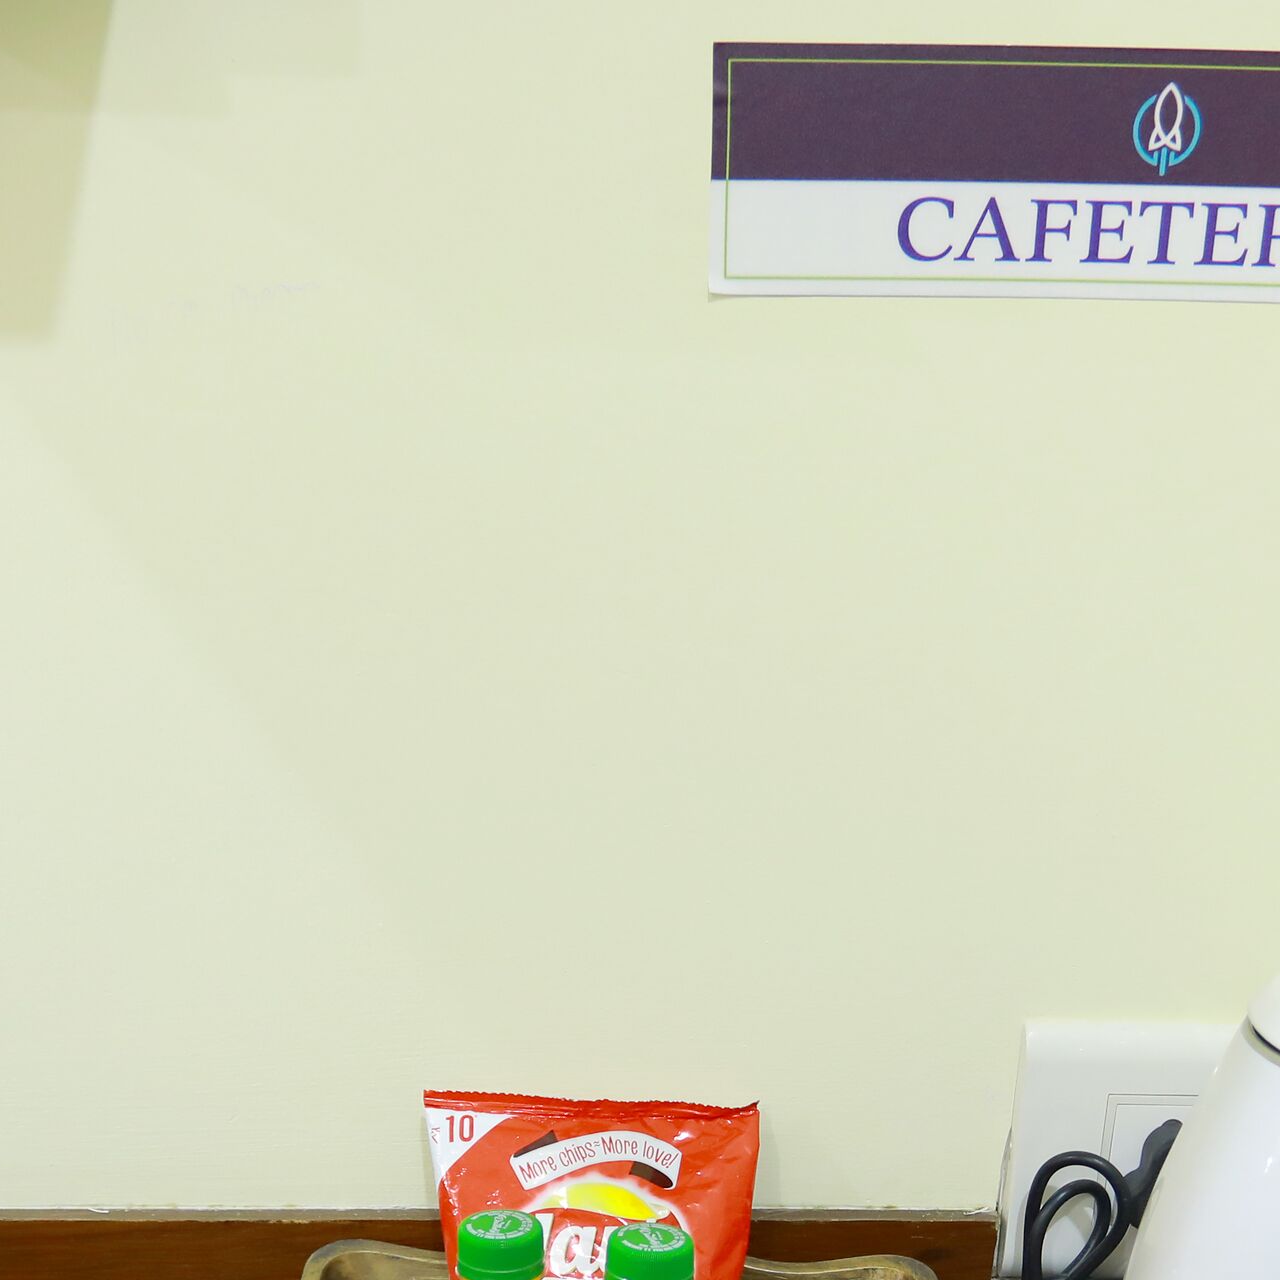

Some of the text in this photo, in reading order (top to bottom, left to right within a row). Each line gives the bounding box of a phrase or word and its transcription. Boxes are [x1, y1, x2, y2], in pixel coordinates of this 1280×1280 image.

[446, 1114, 474, 1142] 10
[518, 1135, 679, 1183] More chips More love!
